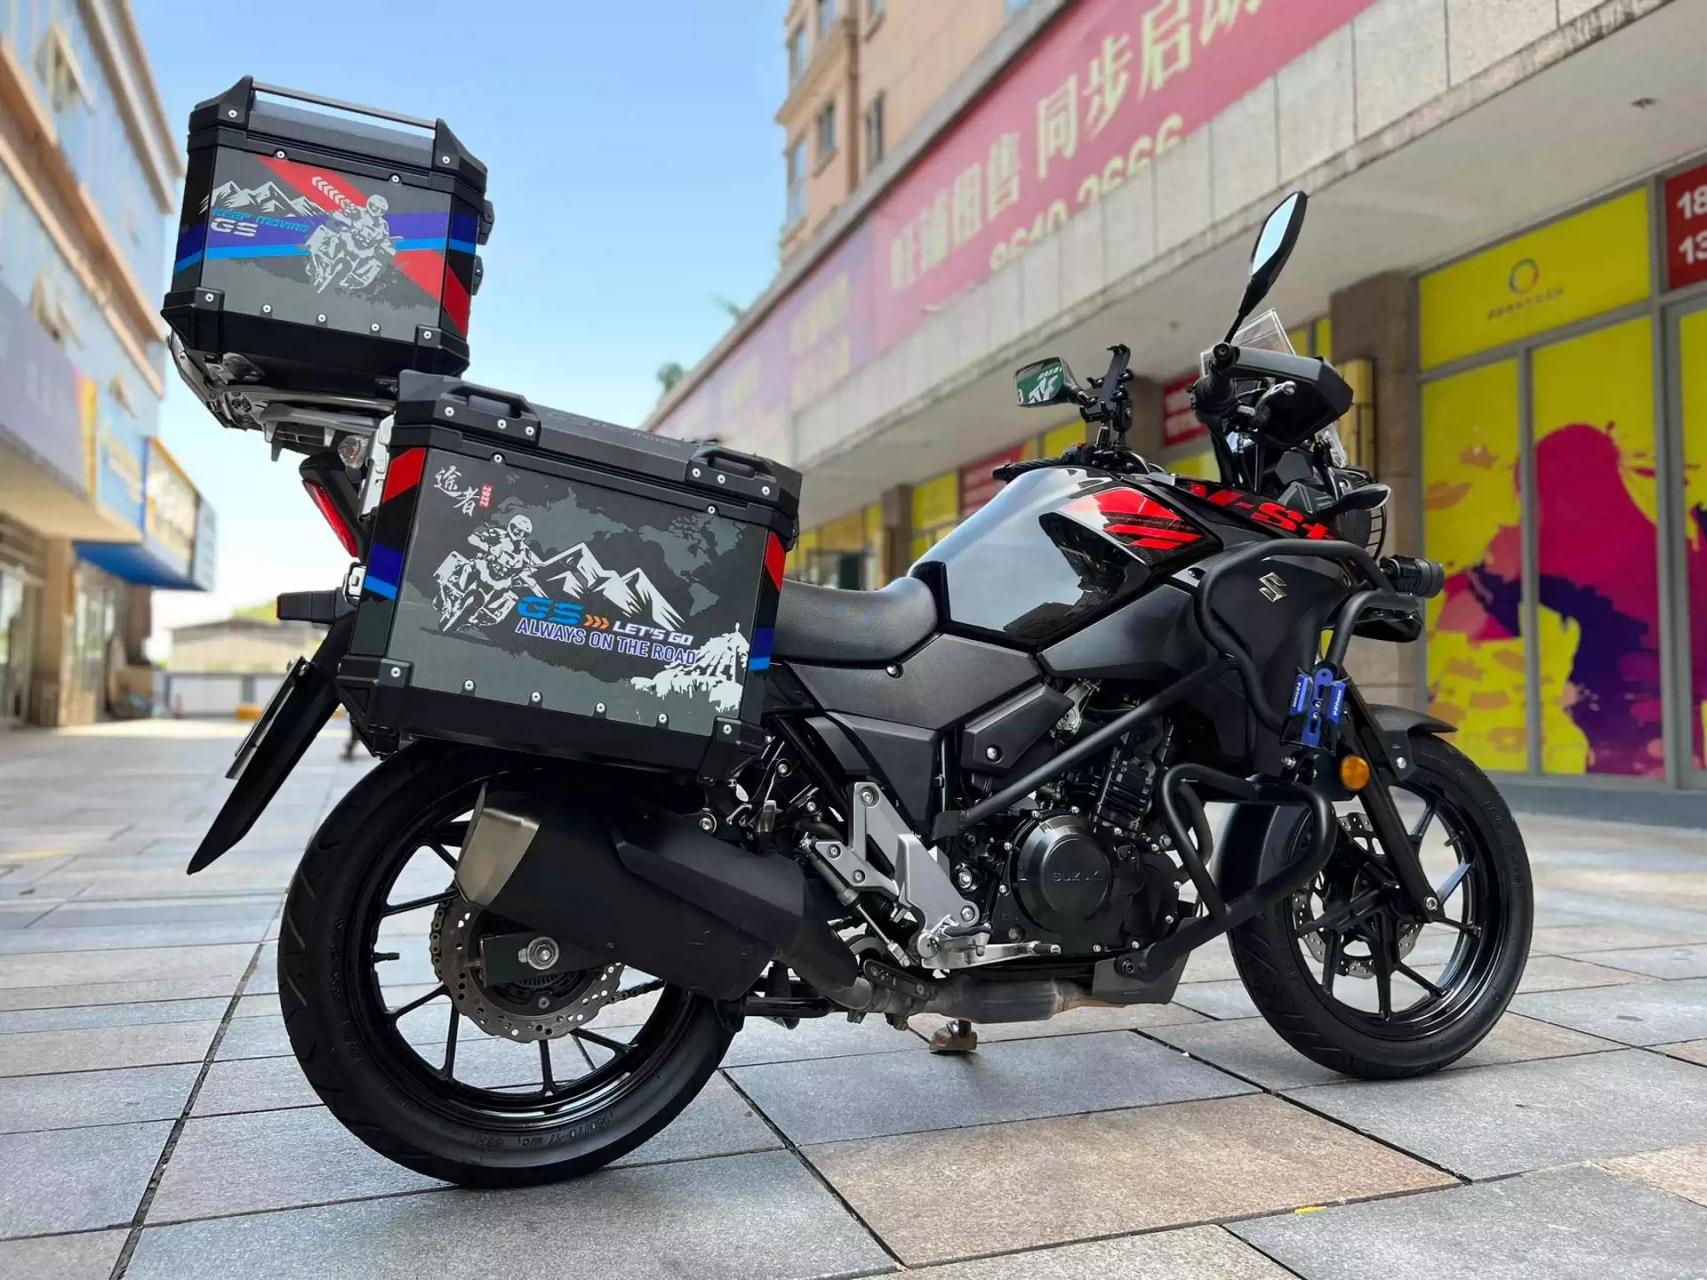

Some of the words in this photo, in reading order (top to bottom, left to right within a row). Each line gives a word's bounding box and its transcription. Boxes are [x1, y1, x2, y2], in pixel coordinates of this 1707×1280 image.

[211, 217, 258, 237] GS
[515, 617, 586, 646] ALWAYS
[589, 632, 614, 651] ON
[617, 636, 650, 658] THE
[651, 644, 697, 666] ROAD
[517, 595, 584, 626] GS
[613, 620, 666, 641] LET'S
[668, 631, 694, 646] GO
